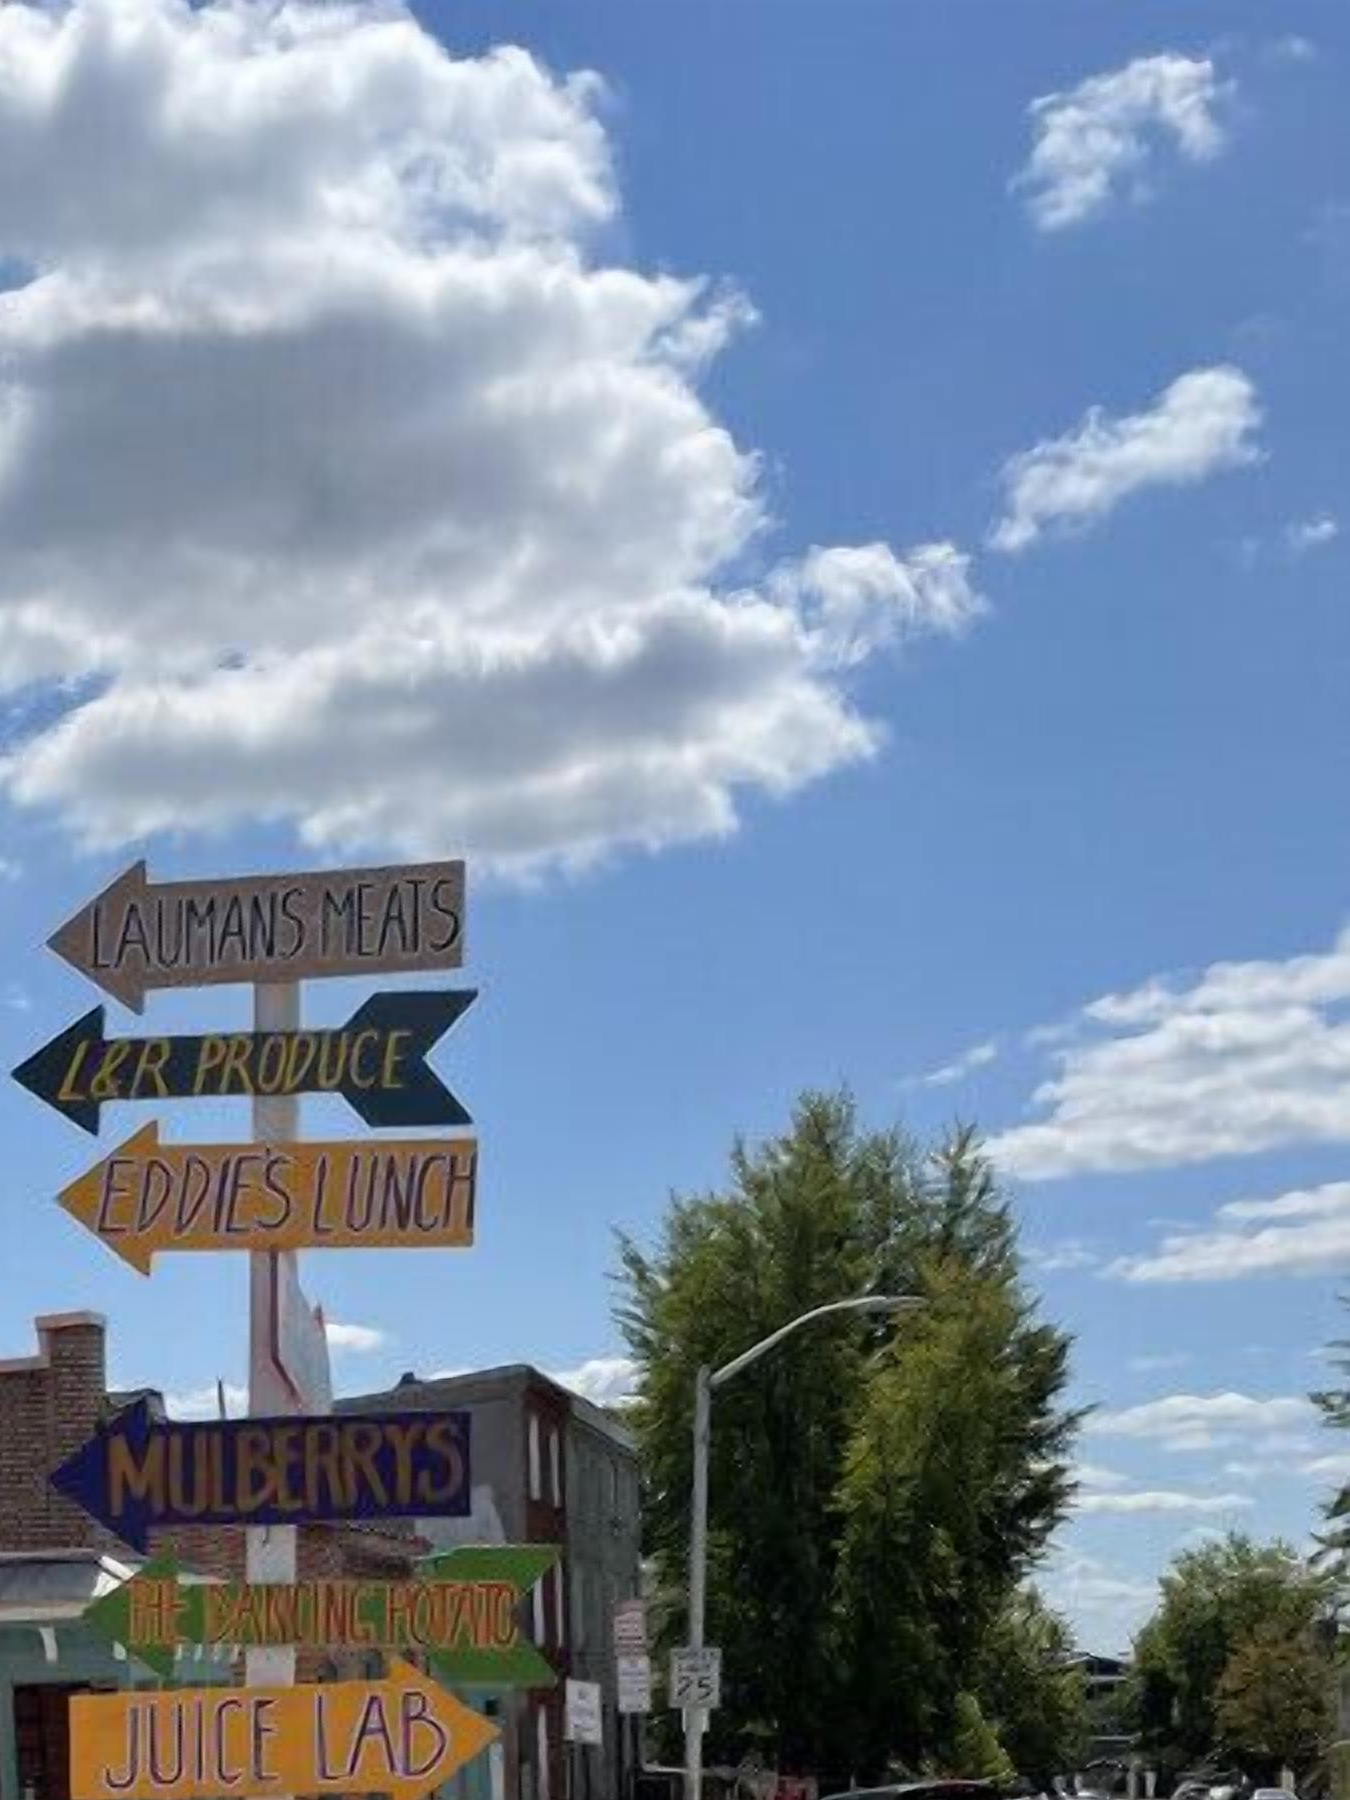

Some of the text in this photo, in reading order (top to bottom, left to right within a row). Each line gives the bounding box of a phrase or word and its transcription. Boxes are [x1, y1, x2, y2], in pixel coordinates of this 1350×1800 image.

[92, 880, 460, 969] LAUMANS MEATS
[58, 1029, 412, 1100] L&R PRODUCE
[98, 1147, 476, 1233] EDDIE'S LUNCH
[107, 1425, 464, 1516] MULBERRYS
[105, 1691, 447, 1788] JUICE LAB
